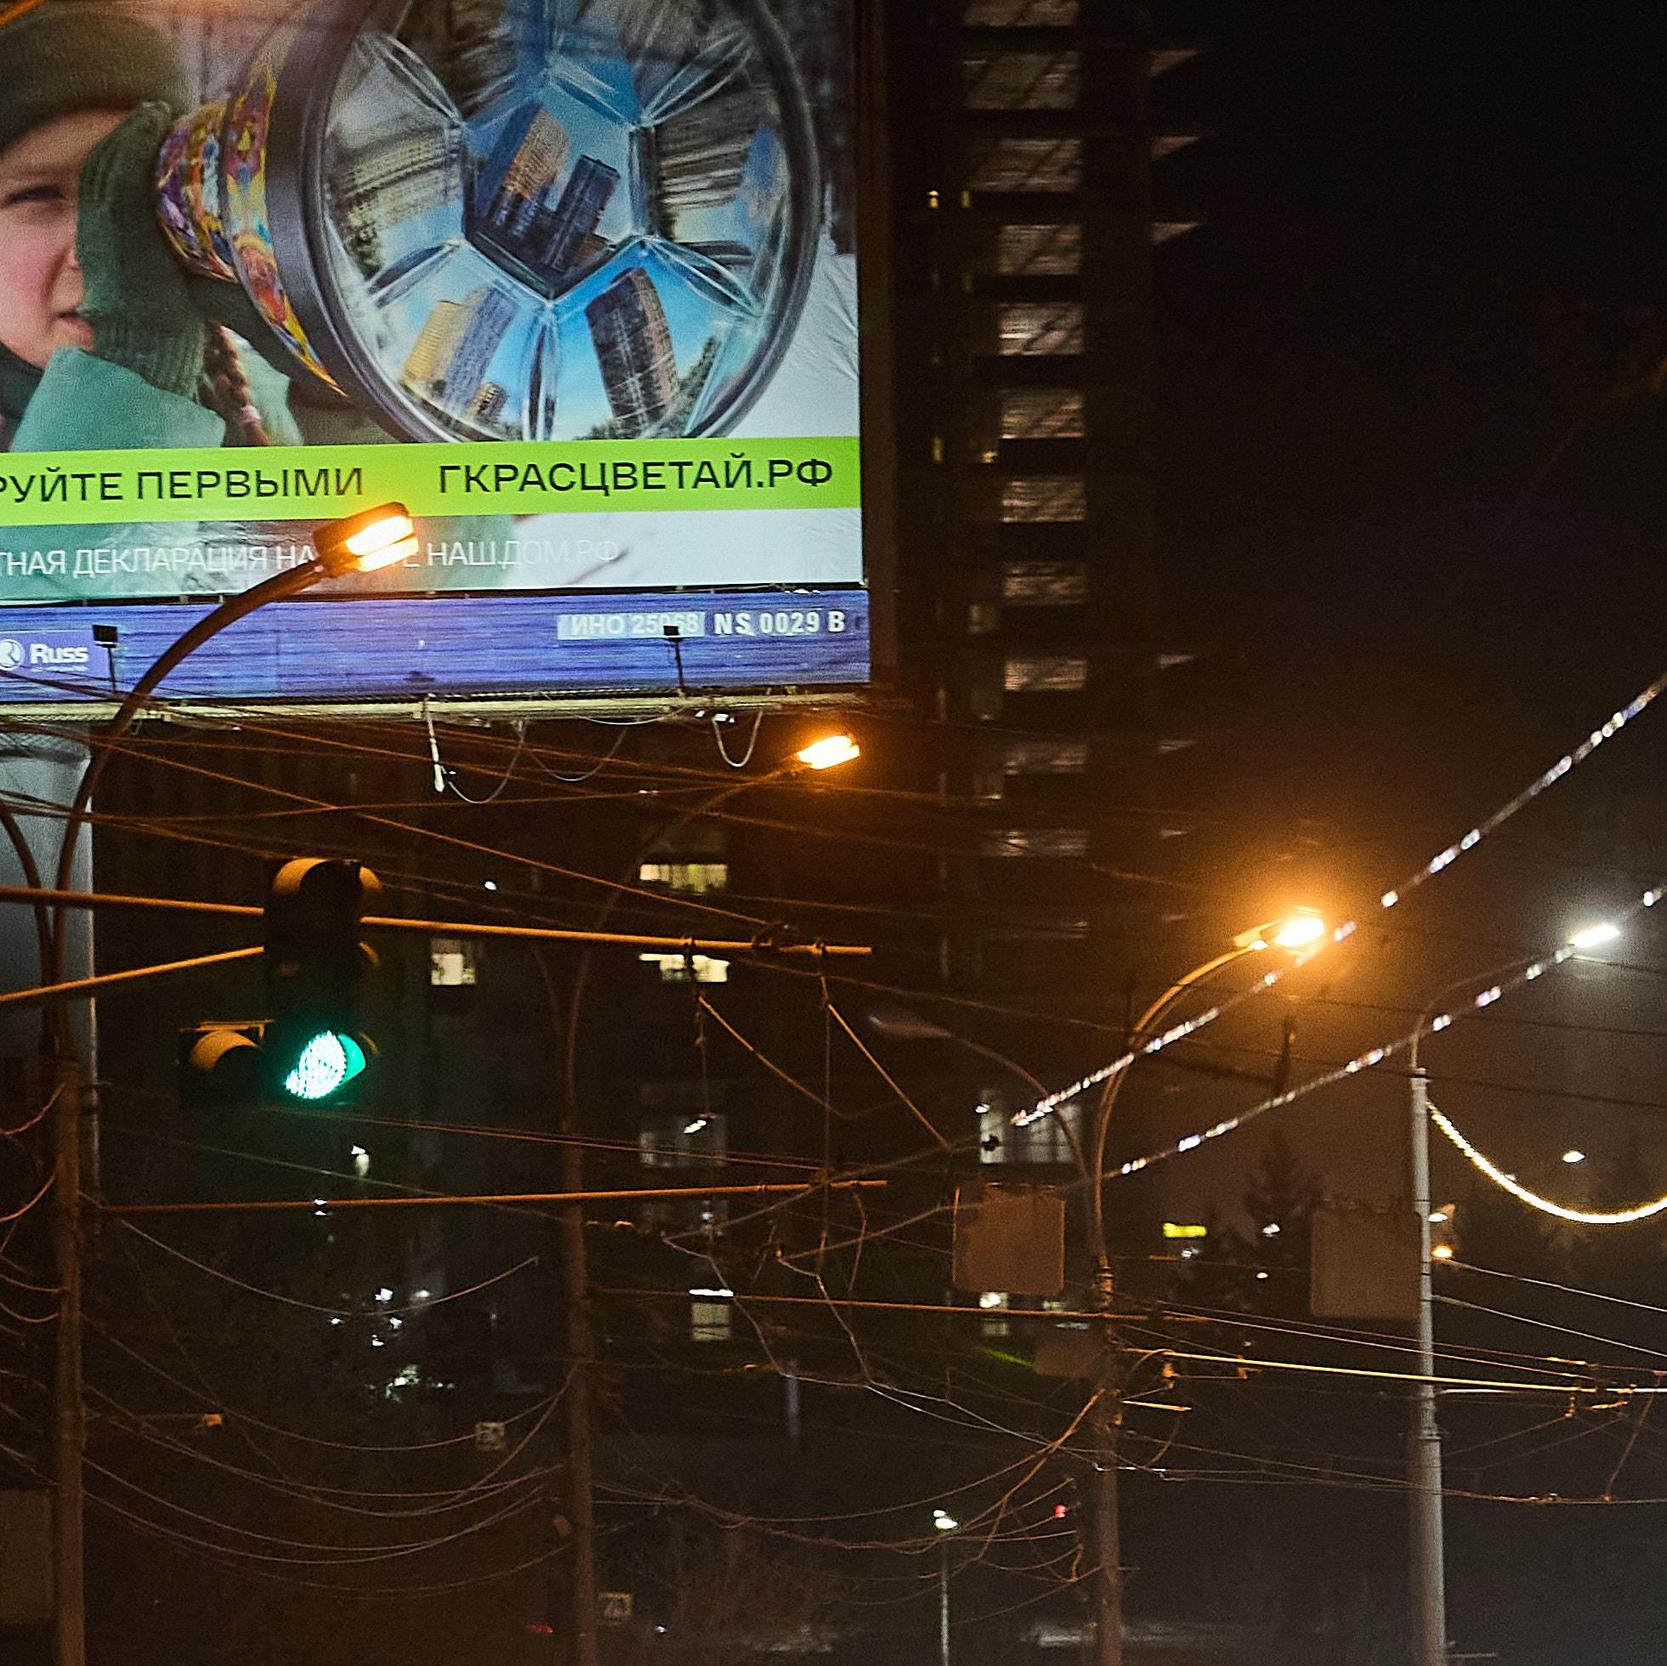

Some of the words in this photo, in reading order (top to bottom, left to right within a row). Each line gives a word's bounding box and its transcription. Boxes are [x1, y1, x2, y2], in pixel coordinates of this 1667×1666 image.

[137, 467, 363, 500] ПЕРВЫМИ
[439, 452, 834, 496] ГКРАСЦВЕТАЙ.РФ
[73, 546, 269, 579] ДЕКЛАРАЦИЯ
[571, 614, 625, 636] ИНО
[714, 612, 752, 635] NS
[758, 610, 821, 635] 0029
[30, 643, 89, 664] Russ
